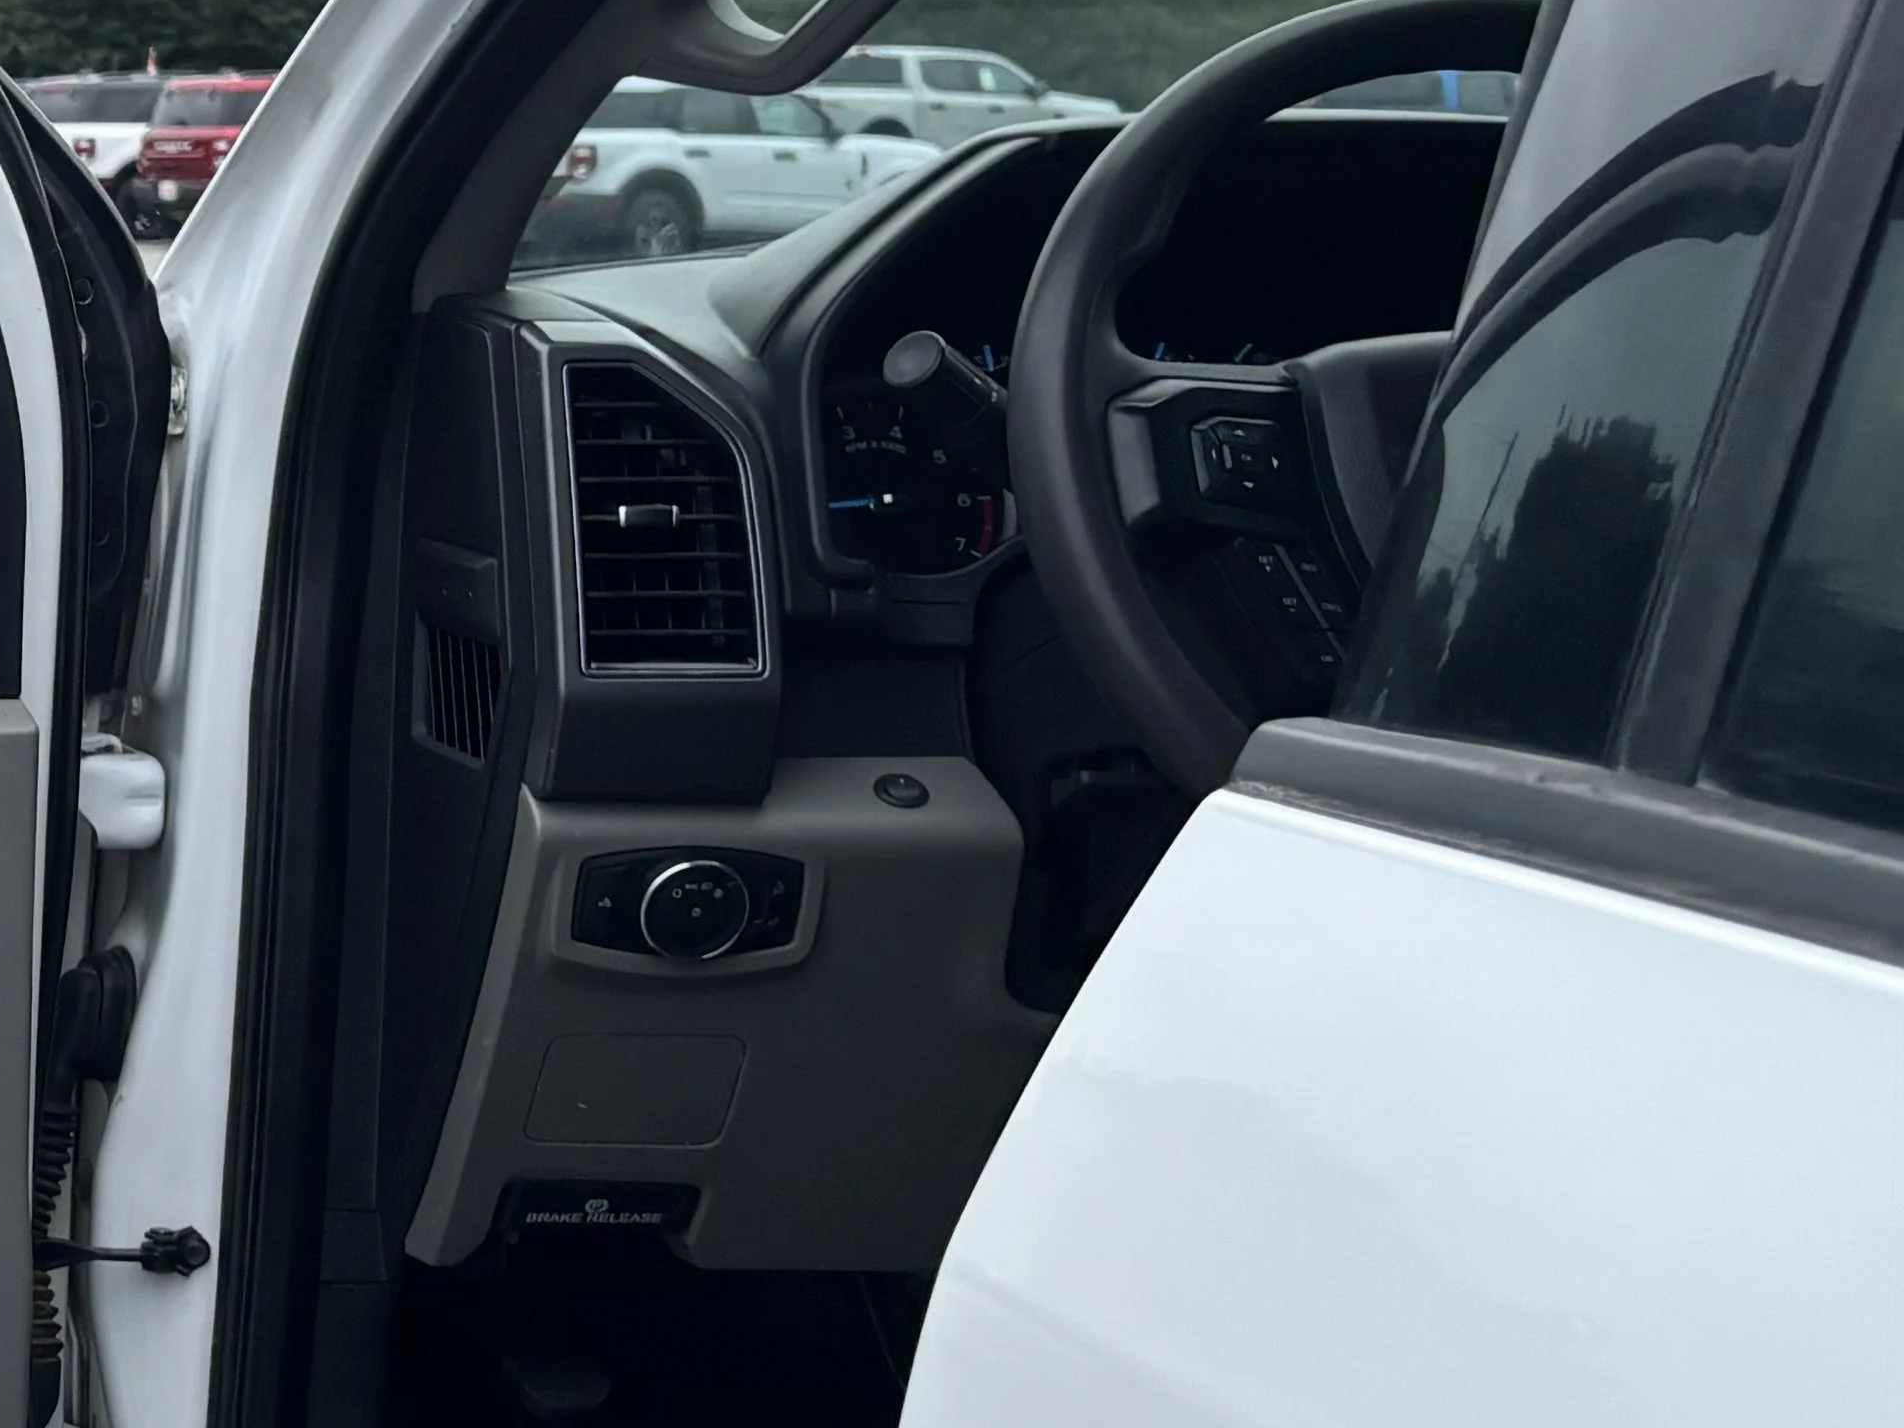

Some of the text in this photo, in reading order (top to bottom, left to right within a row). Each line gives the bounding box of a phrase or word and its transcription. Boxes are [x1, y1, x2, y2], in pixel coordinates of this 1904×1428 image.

[841, 425, 856, 441] 3
[887, 425, 903, 440] 4
[932, 449, 948, 464] 5
[956, 492, 972, 508] 6
[954, 537, 967, 552] 7
[526, 1212, 663, 1224] BRAKE RELEASE
